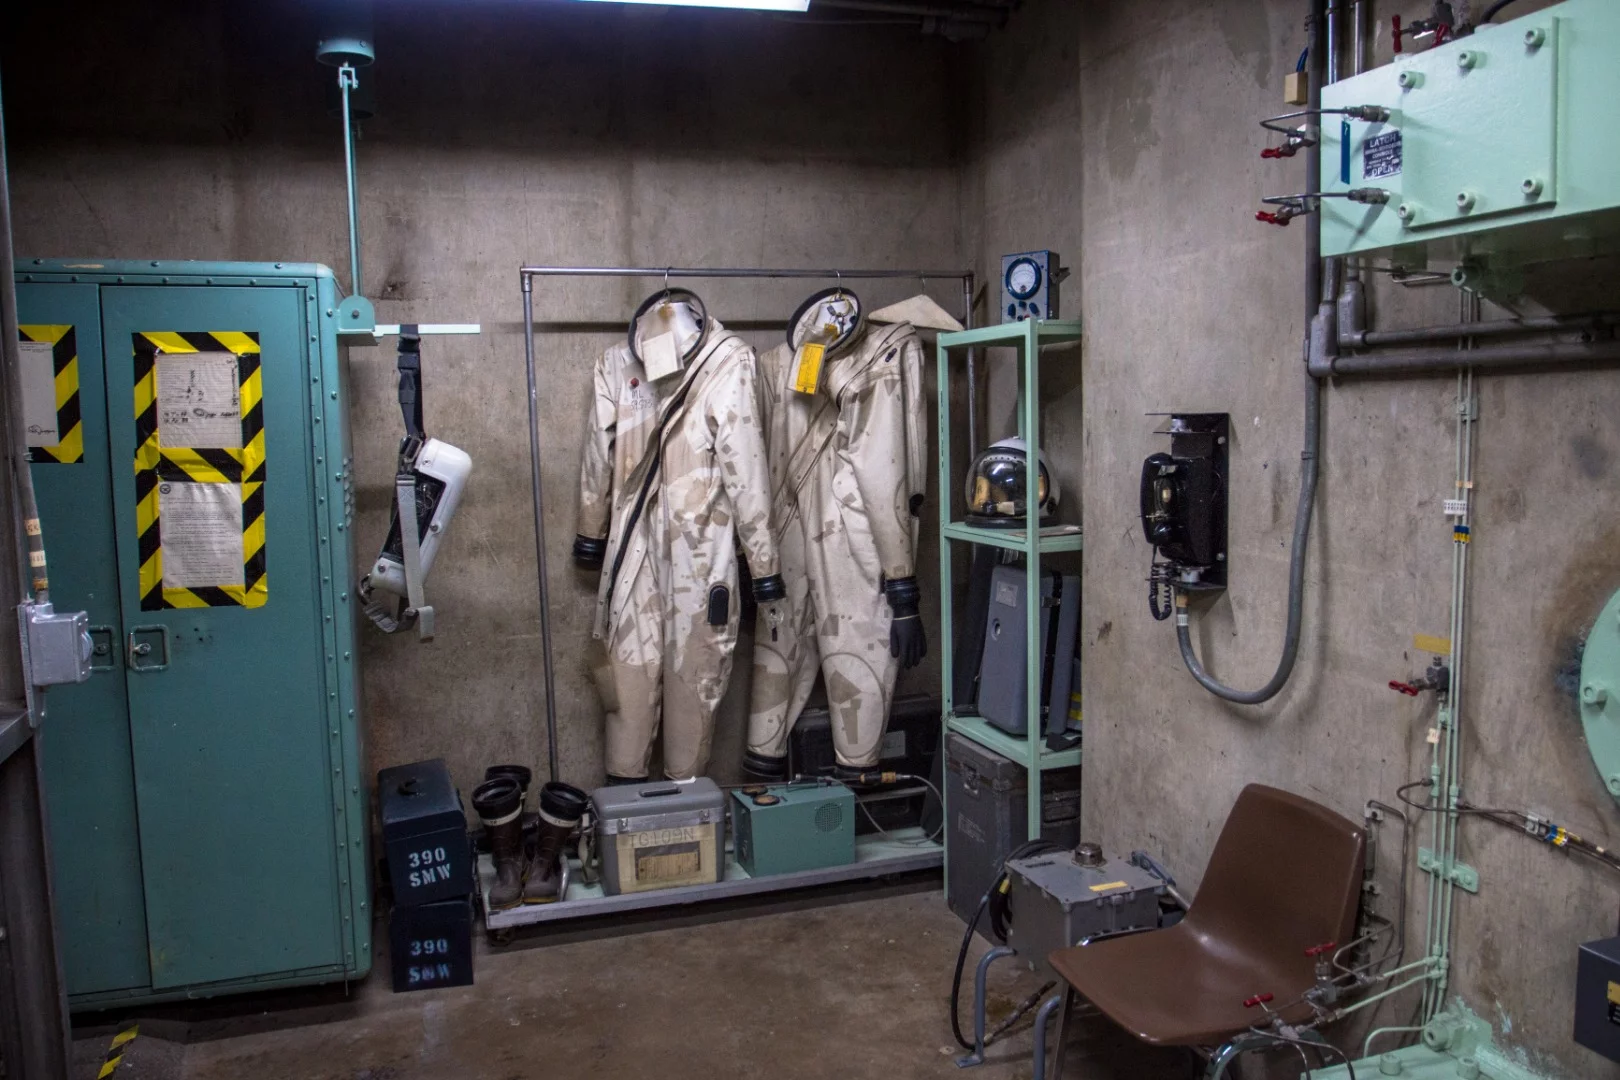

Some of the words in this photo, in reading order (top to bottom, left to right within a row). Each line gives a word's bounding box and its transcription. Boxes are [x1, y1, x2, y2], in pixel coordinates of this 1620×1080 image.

[408, 847, 446, 868] 390
[409, 863, 451, 887] SMW
[410, 938, 448, 957] 390
